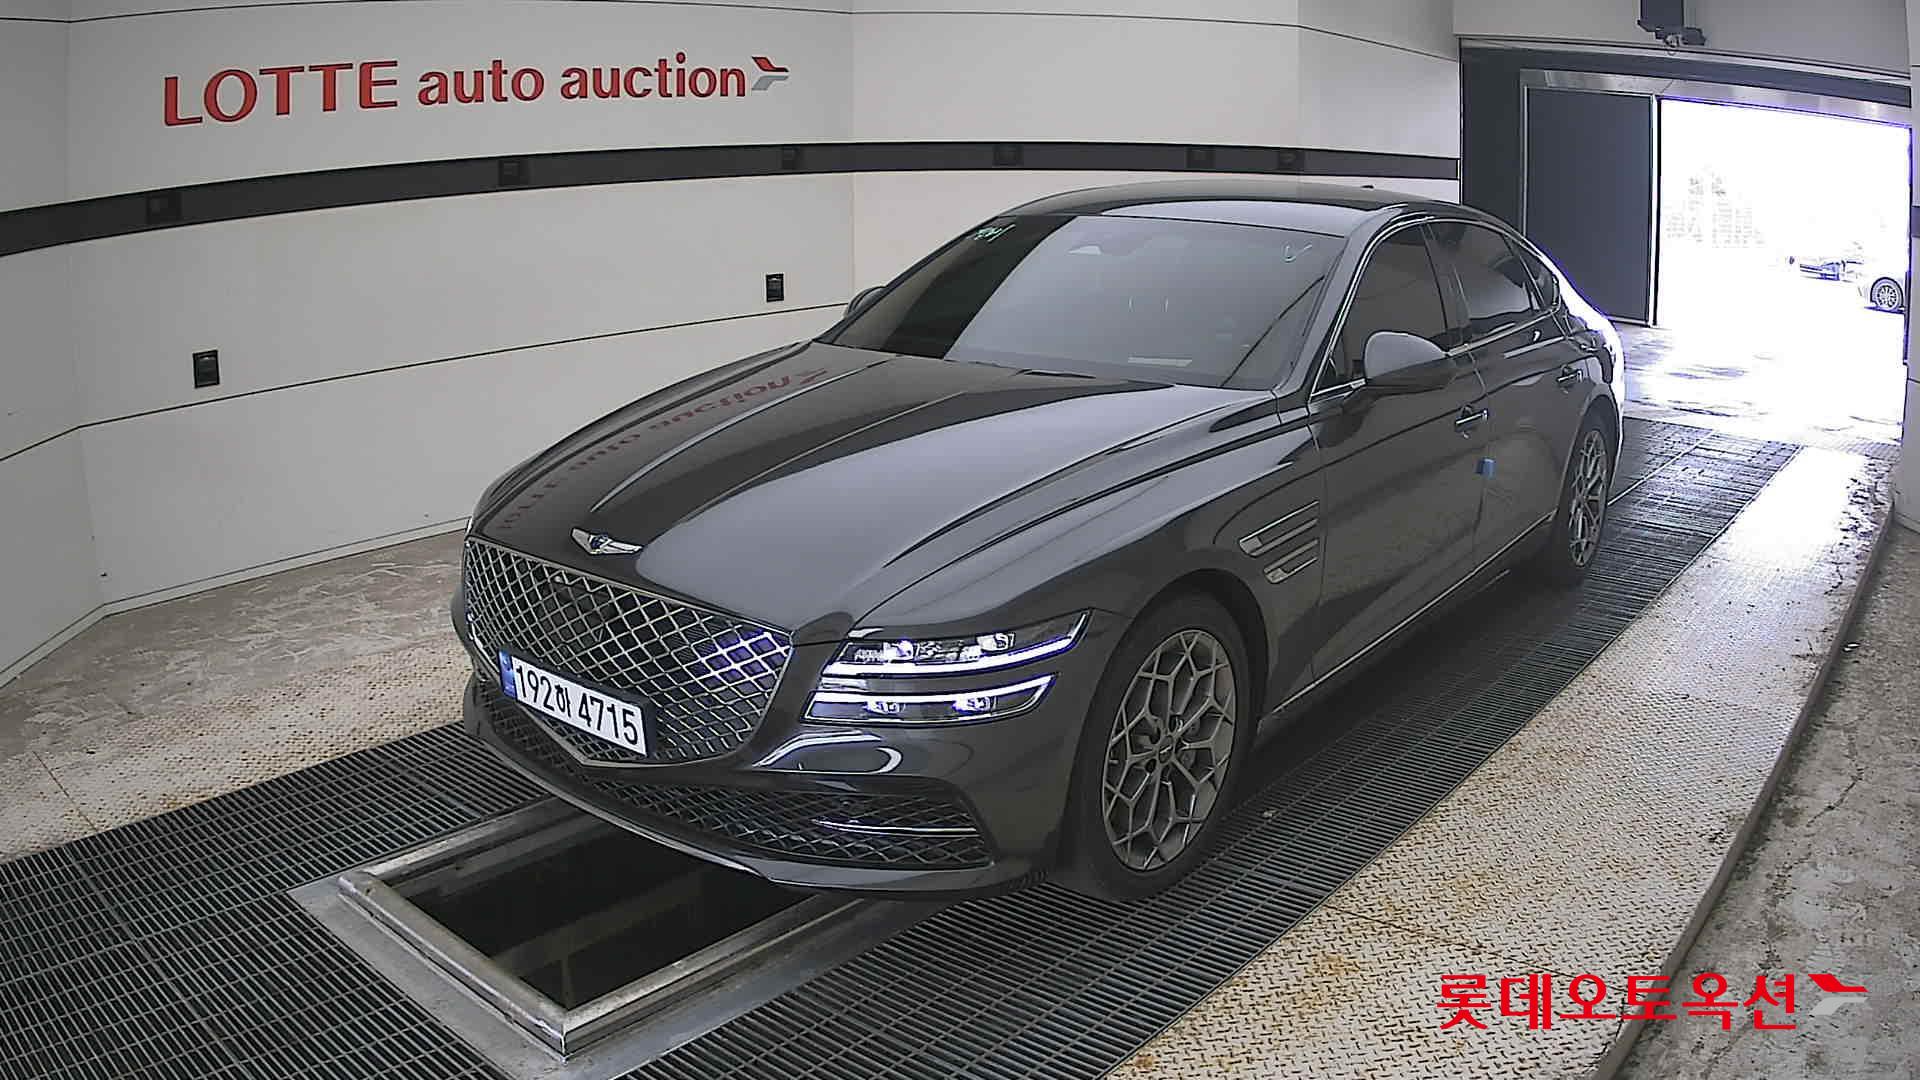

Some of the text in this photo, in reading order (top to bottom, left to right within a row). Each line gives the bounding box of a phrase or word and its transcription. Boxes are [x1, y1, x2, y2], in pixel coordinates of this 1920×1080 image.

[163, 51, 749, 126] LOTTE auto auction
[516, 665, 638, 745] 192하 4715
